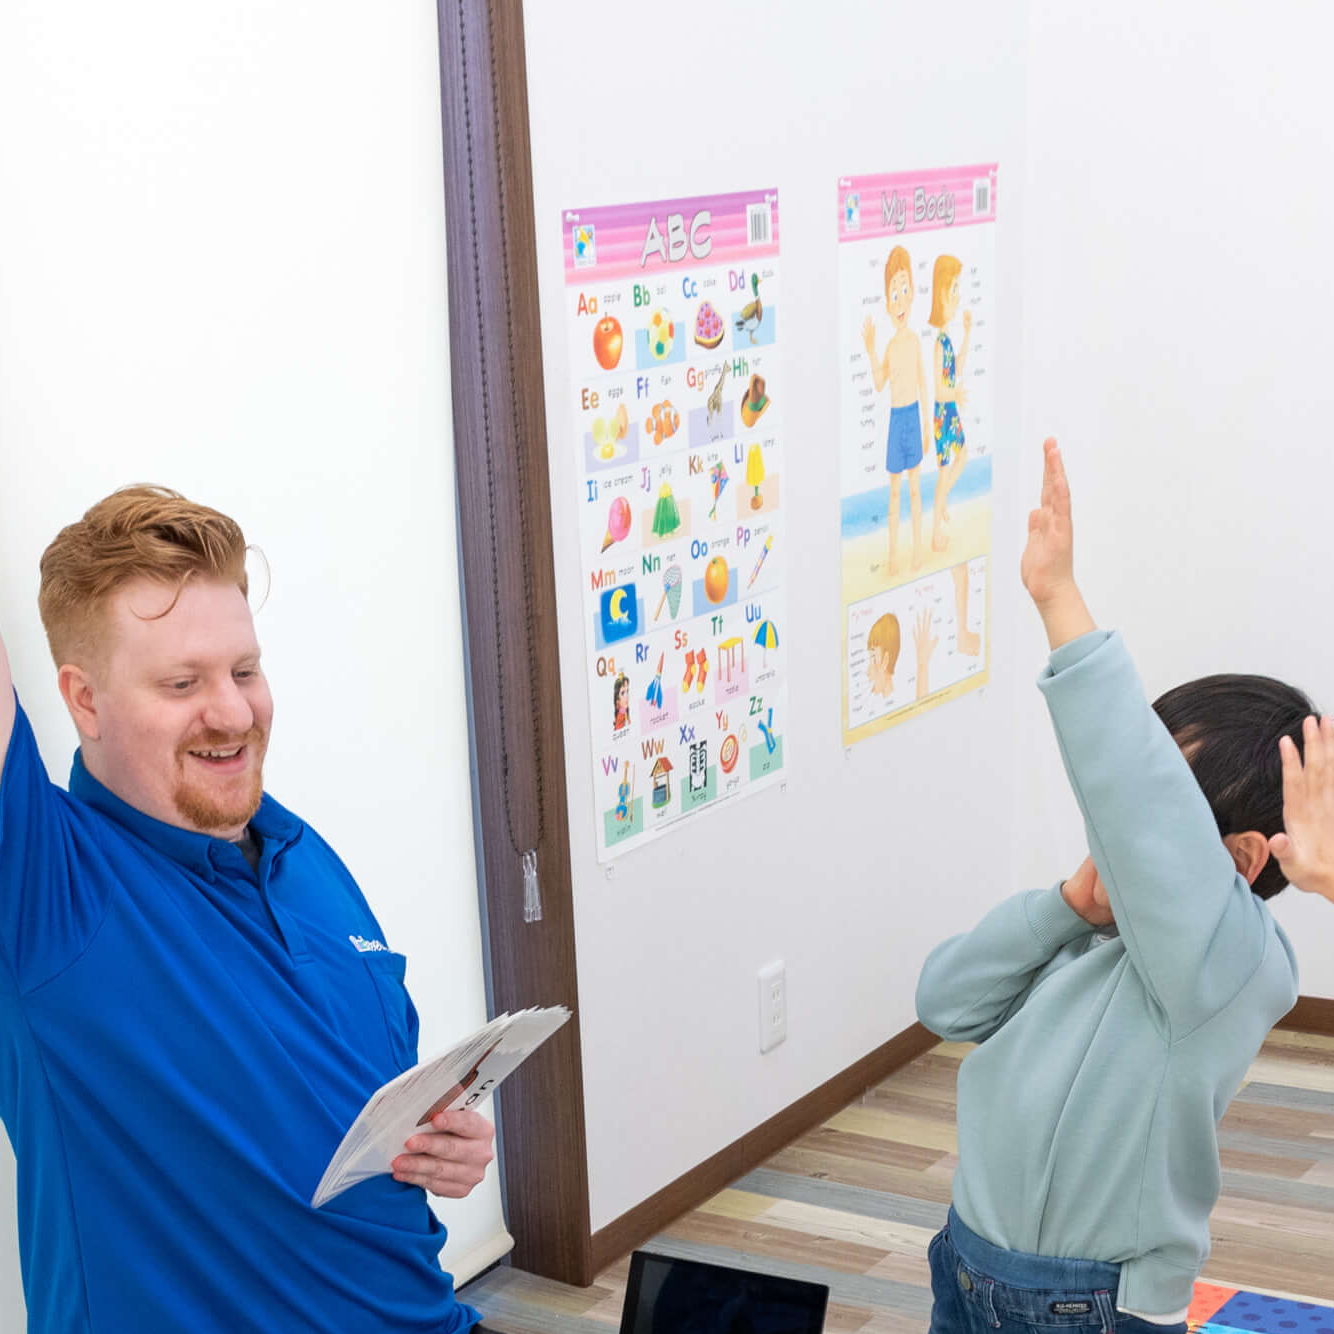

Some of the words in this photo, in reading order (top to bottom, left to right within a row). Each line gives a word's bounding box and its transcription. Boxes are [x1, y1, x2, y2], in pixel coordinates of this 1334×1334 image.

[881, 191, 906, 233] My
[914, 186, 956, 226] Body
[640, 209, 712, 268] ABC
[682, 277, 698, 298] Cc
[728, 270, 745, 291] Dd
[577, 293, 598, 316] Aa
[633, 284, 651, 307] Bb
[732, 357, 749, 377] Hh
[636, 377, 649, 399] Ff
[686, 367, 704, 391] Gg
[581, 388, 599, 410] Ee
[689, 455, 703, 475] Kk
[640, 467, 651, 493] Jj
[736, 526, 750, 548] Pp
[691, 539, 708, 559] Oo
[642, 554, 661, 575] Nn
[591, 569, 616, 591] Mm
[745, 603, 761, 623] Uu
[711, 615, 723, 636] Tt
[674, 630, 688, 650] Ss
[635, 643, 650, 664] Rr
[596, 657, 616, 677] Qq
[749, 696, 763, 716] Zz
[715, 710, 729, 731] Yy
[679, 725, 695, 745] Xx
[641, 738, 665, 760] Ww
[602, 756, 618, 776] Vv
